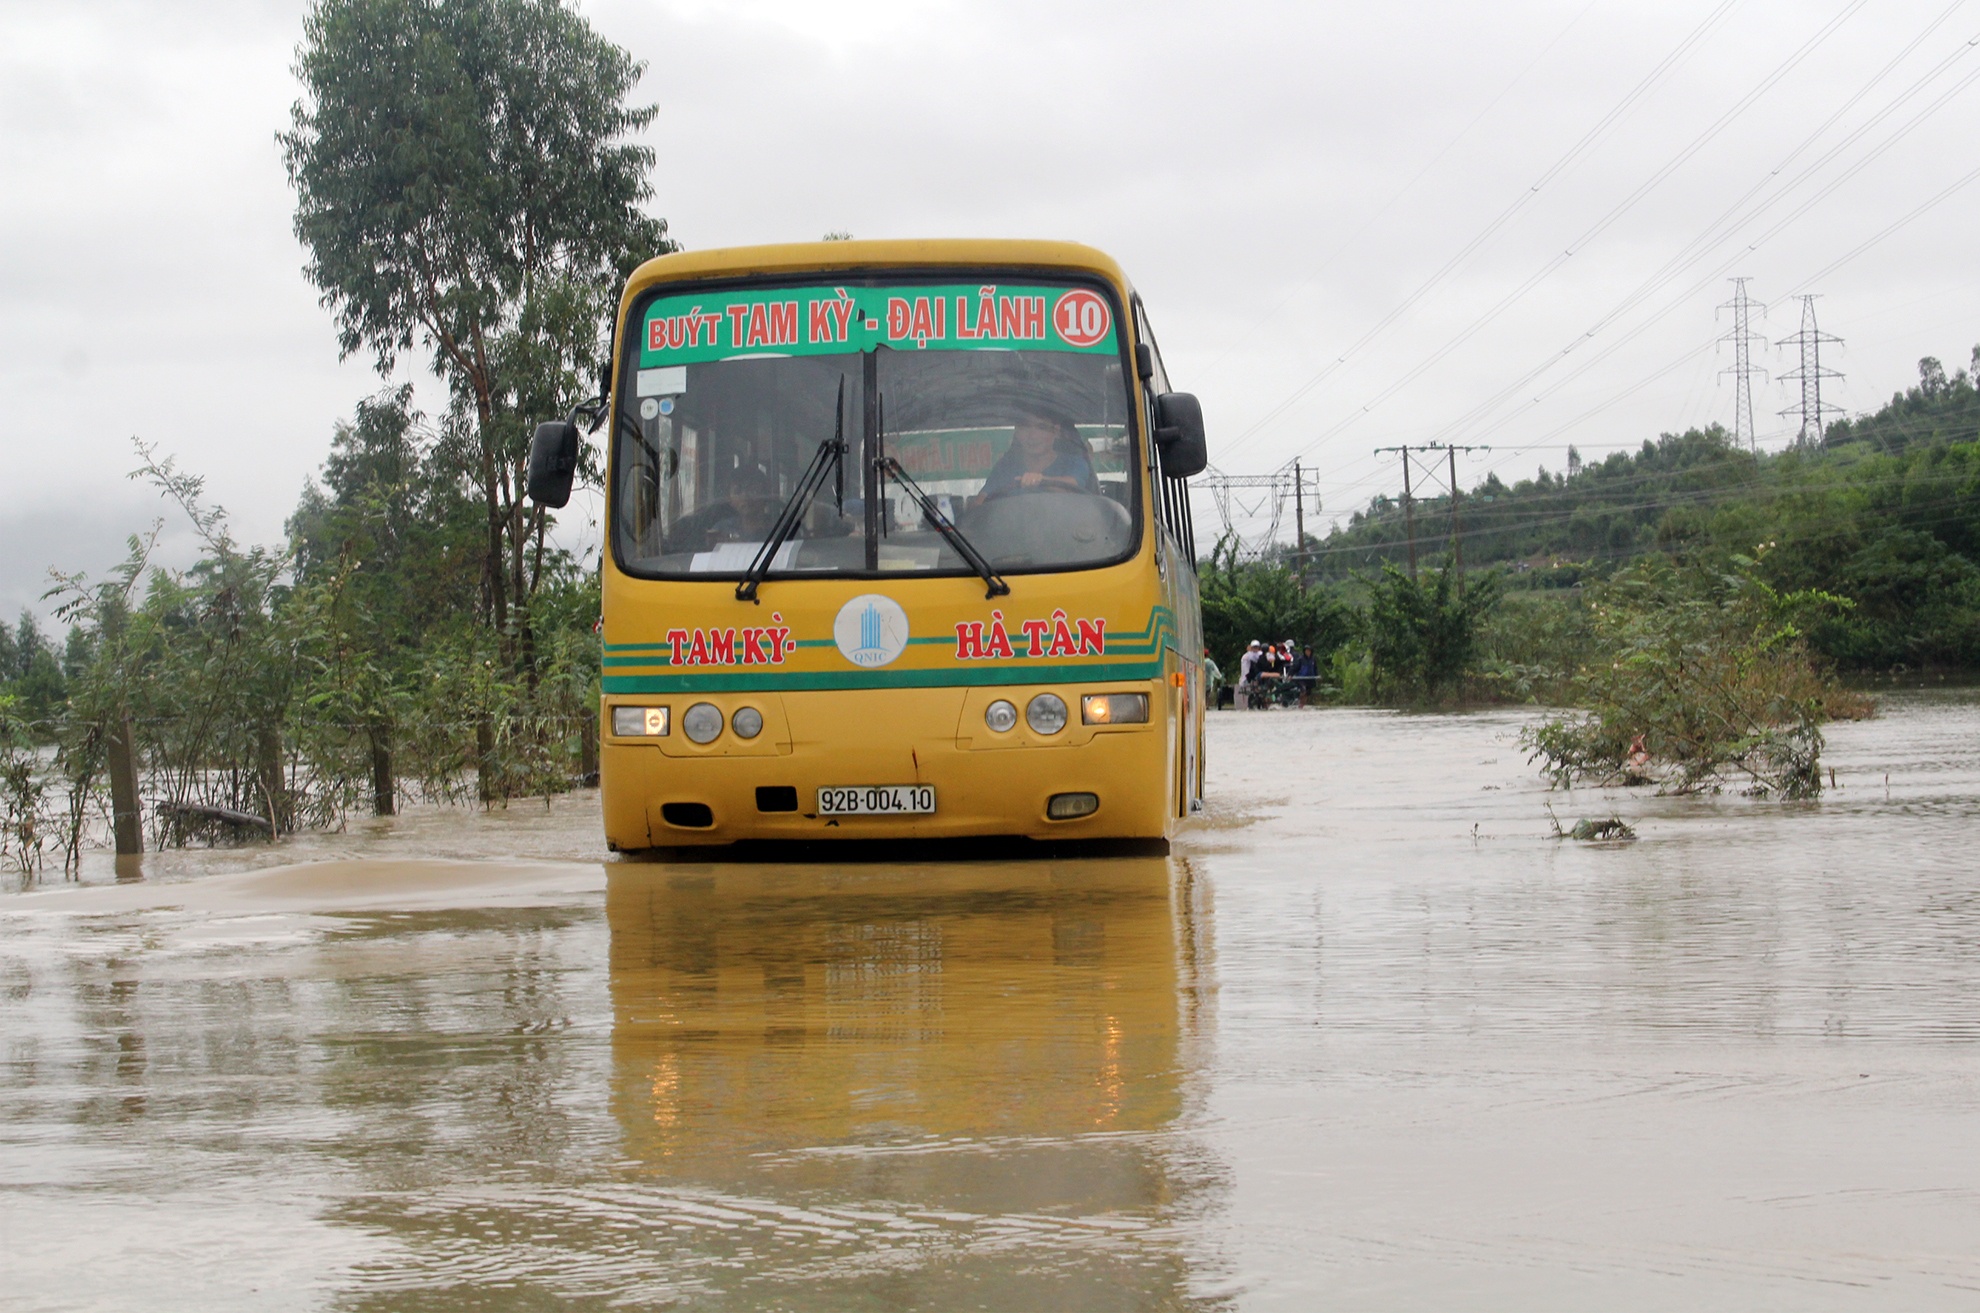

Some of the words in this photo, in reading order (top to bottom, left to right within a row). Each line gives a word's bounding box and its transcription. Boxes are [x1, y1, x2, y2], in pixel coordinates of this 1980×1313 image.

[648, 306, 722, 351] BUÝT
[727, 300, 798, 348] TAM
[808, 287, 855, 343] KỲ
[887, 297, 945, 349] ĐẠI
[956, 285, 1045, 339] LÃNH
[1063, 300, 1103, 337] 10
[667, 628, 736, 666] TAM
[955, 609, 1015, 659] HÀ
[1022, 608, 1106, 658] TÂN
[854, 652, 887, 664] QNIC
[821, 788, 931, 812] 92B-004.10
